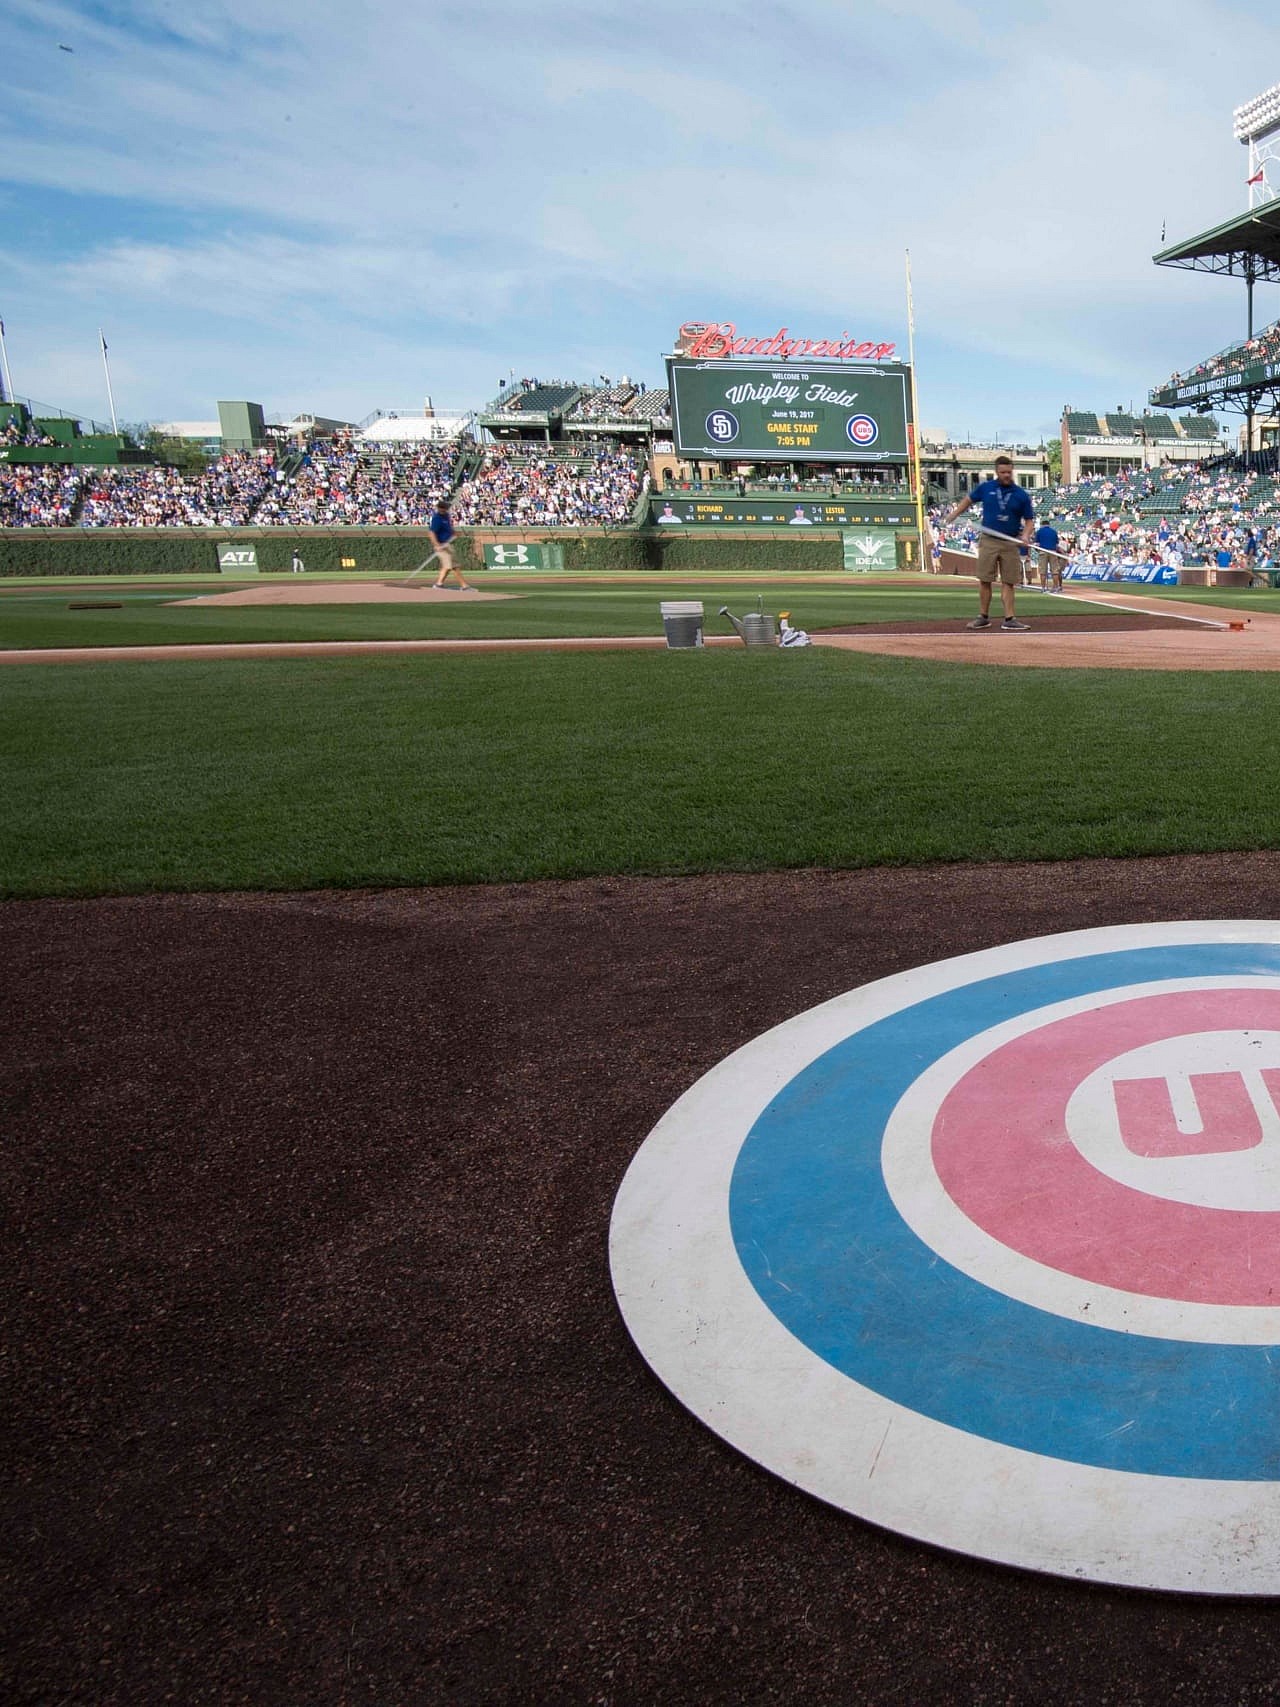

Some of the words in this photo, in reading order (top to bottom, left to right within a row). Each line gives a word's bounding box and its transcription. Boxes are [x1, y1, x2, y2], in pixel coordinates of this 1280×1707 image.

[681, 321, 896, 359] Budweiser
[772, 373, 800, 381] WELCOME
[801, 373, 809, 381] TO
[1177, 384, 1199, 400] WELCOME
[1227, 373, 1242, 387] FIELD
[725, 381, 800, 405] Wrigley
[805, 384, 859, 407] Field
[772, 411, 788, 419] June
[767, 423, 793, 434] GAME
[795, 424, 819, 434] START
[777, 437, 795, 446] 7:05
[798, 437, 811, 447] PM
[220, 551, 255, 562] ATI
[855, 557, 886, 566] IDEAL
